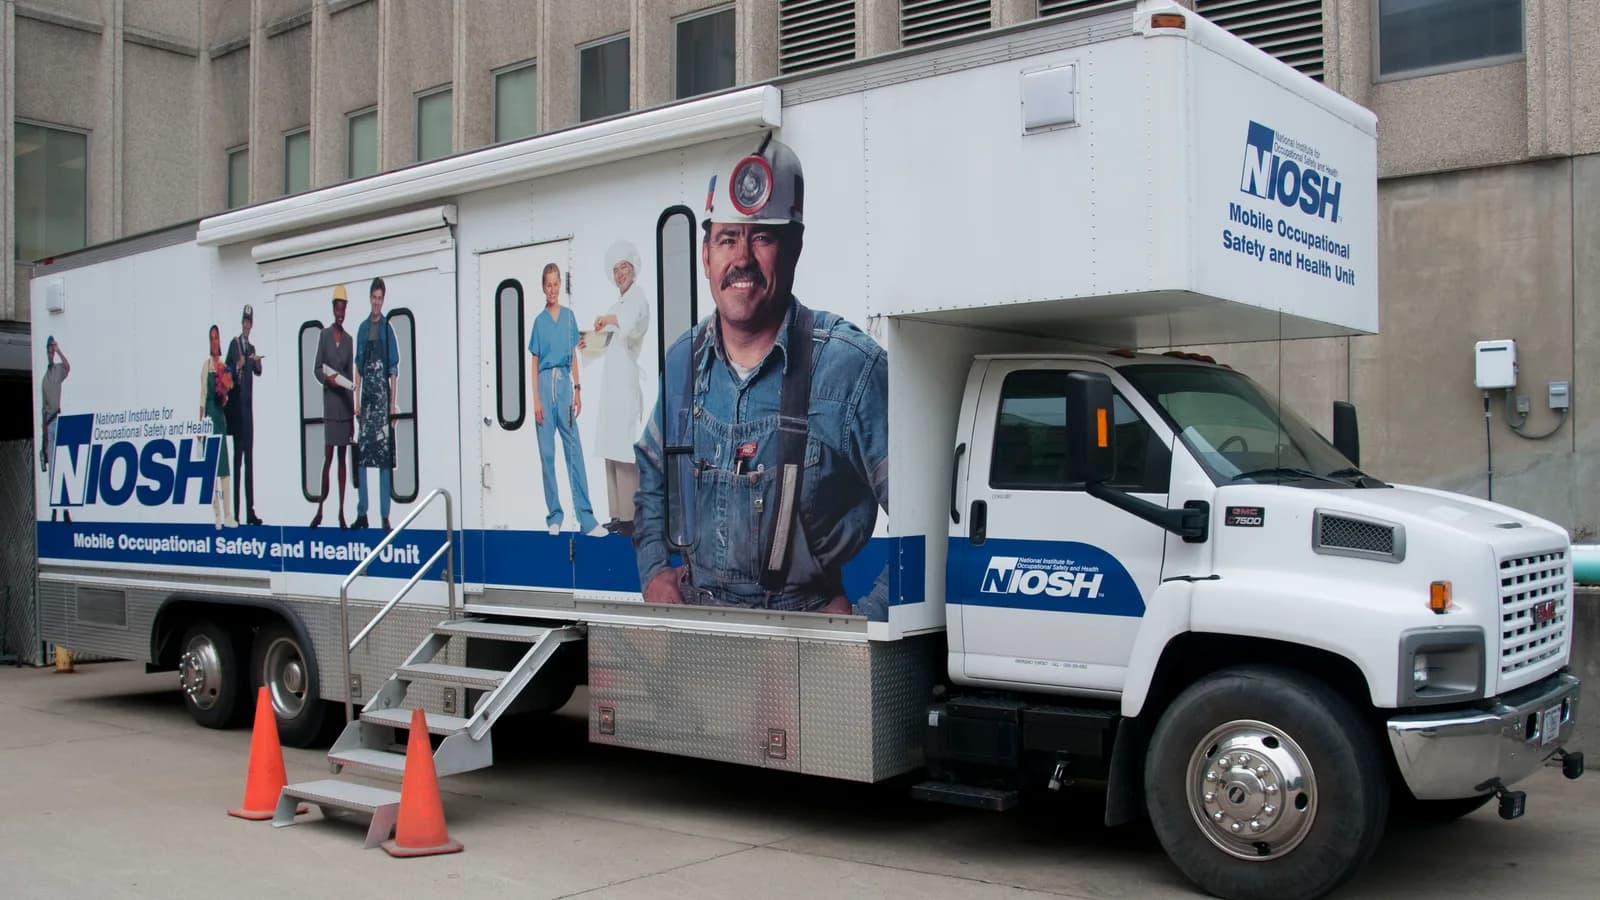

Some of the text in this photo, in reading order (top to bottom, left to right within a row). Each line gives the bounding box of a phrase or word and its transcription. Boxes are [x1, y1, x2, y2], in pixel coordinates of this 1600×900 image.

[1241, 143, 1341, 223] NIOSH
[1230, 202, 1350, 260] Mobile Occupational
[1223, 229, 1355, 286] Safety and Health Unit
[94, 418, 213, 441] Occupational Safety and Health
[95, 406, 174, 425] National Institute for
[51, 437, 221, 506] NIOSH
[73, 532, 421, 564] Mobile Occupational Safety and Health Unit
[1017, 562, 1051, 570] Occupational
[981, 568, 1104, 598] NIOSH
